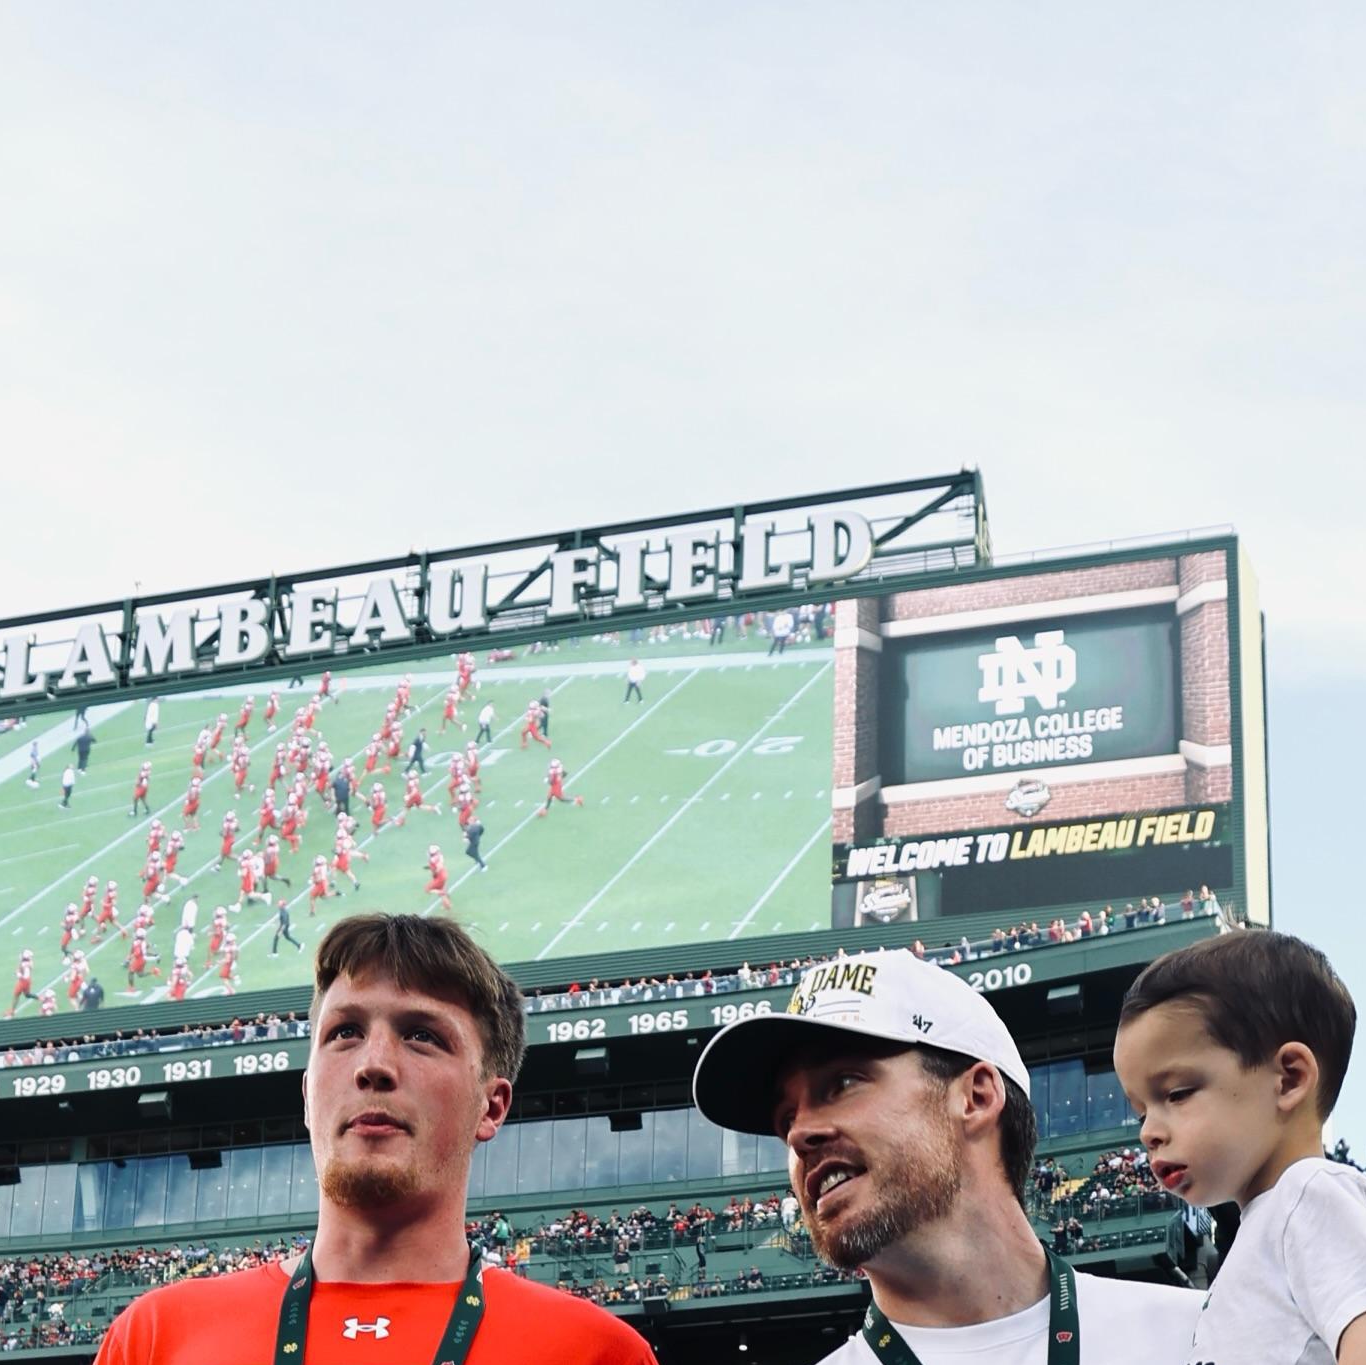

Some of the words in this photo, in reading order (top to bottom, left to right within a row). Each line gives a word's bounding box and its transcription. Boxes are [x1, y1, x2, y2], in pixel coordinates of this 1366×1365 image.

[0, 566, 489, 698] LAMBEAU
[547, 510, 876, 618] FIELD
[933, 717, 1031, 750] MENDOZA
[1034, 706, 1124, 738] COLLEGE
[963, 746, 990, 771] OF
[992, 734, 1093, 767] BUSINESS
[847, 836, 973, 876] WELCOME
[976, 832, 1010, 864] TO
[1010, 818, 1138, 860] LAMBEAU
[1136, 810, 1216, 847] FIELD
[811, 963, 878, 996] DAME
[12, 1075, 66, 1096] 1929
[87, 1067, 141, 1090] 1930
[163, 1059, 213, 1082] 1931
[233, 1051, 290, 1074] 1936
[547, 1018, 606, 1042] 1962
[628, 1010, 688, 1034] 1965
[710, 1000, 772, 1024] 1966
[969, 963, 1033, 993] 2010
